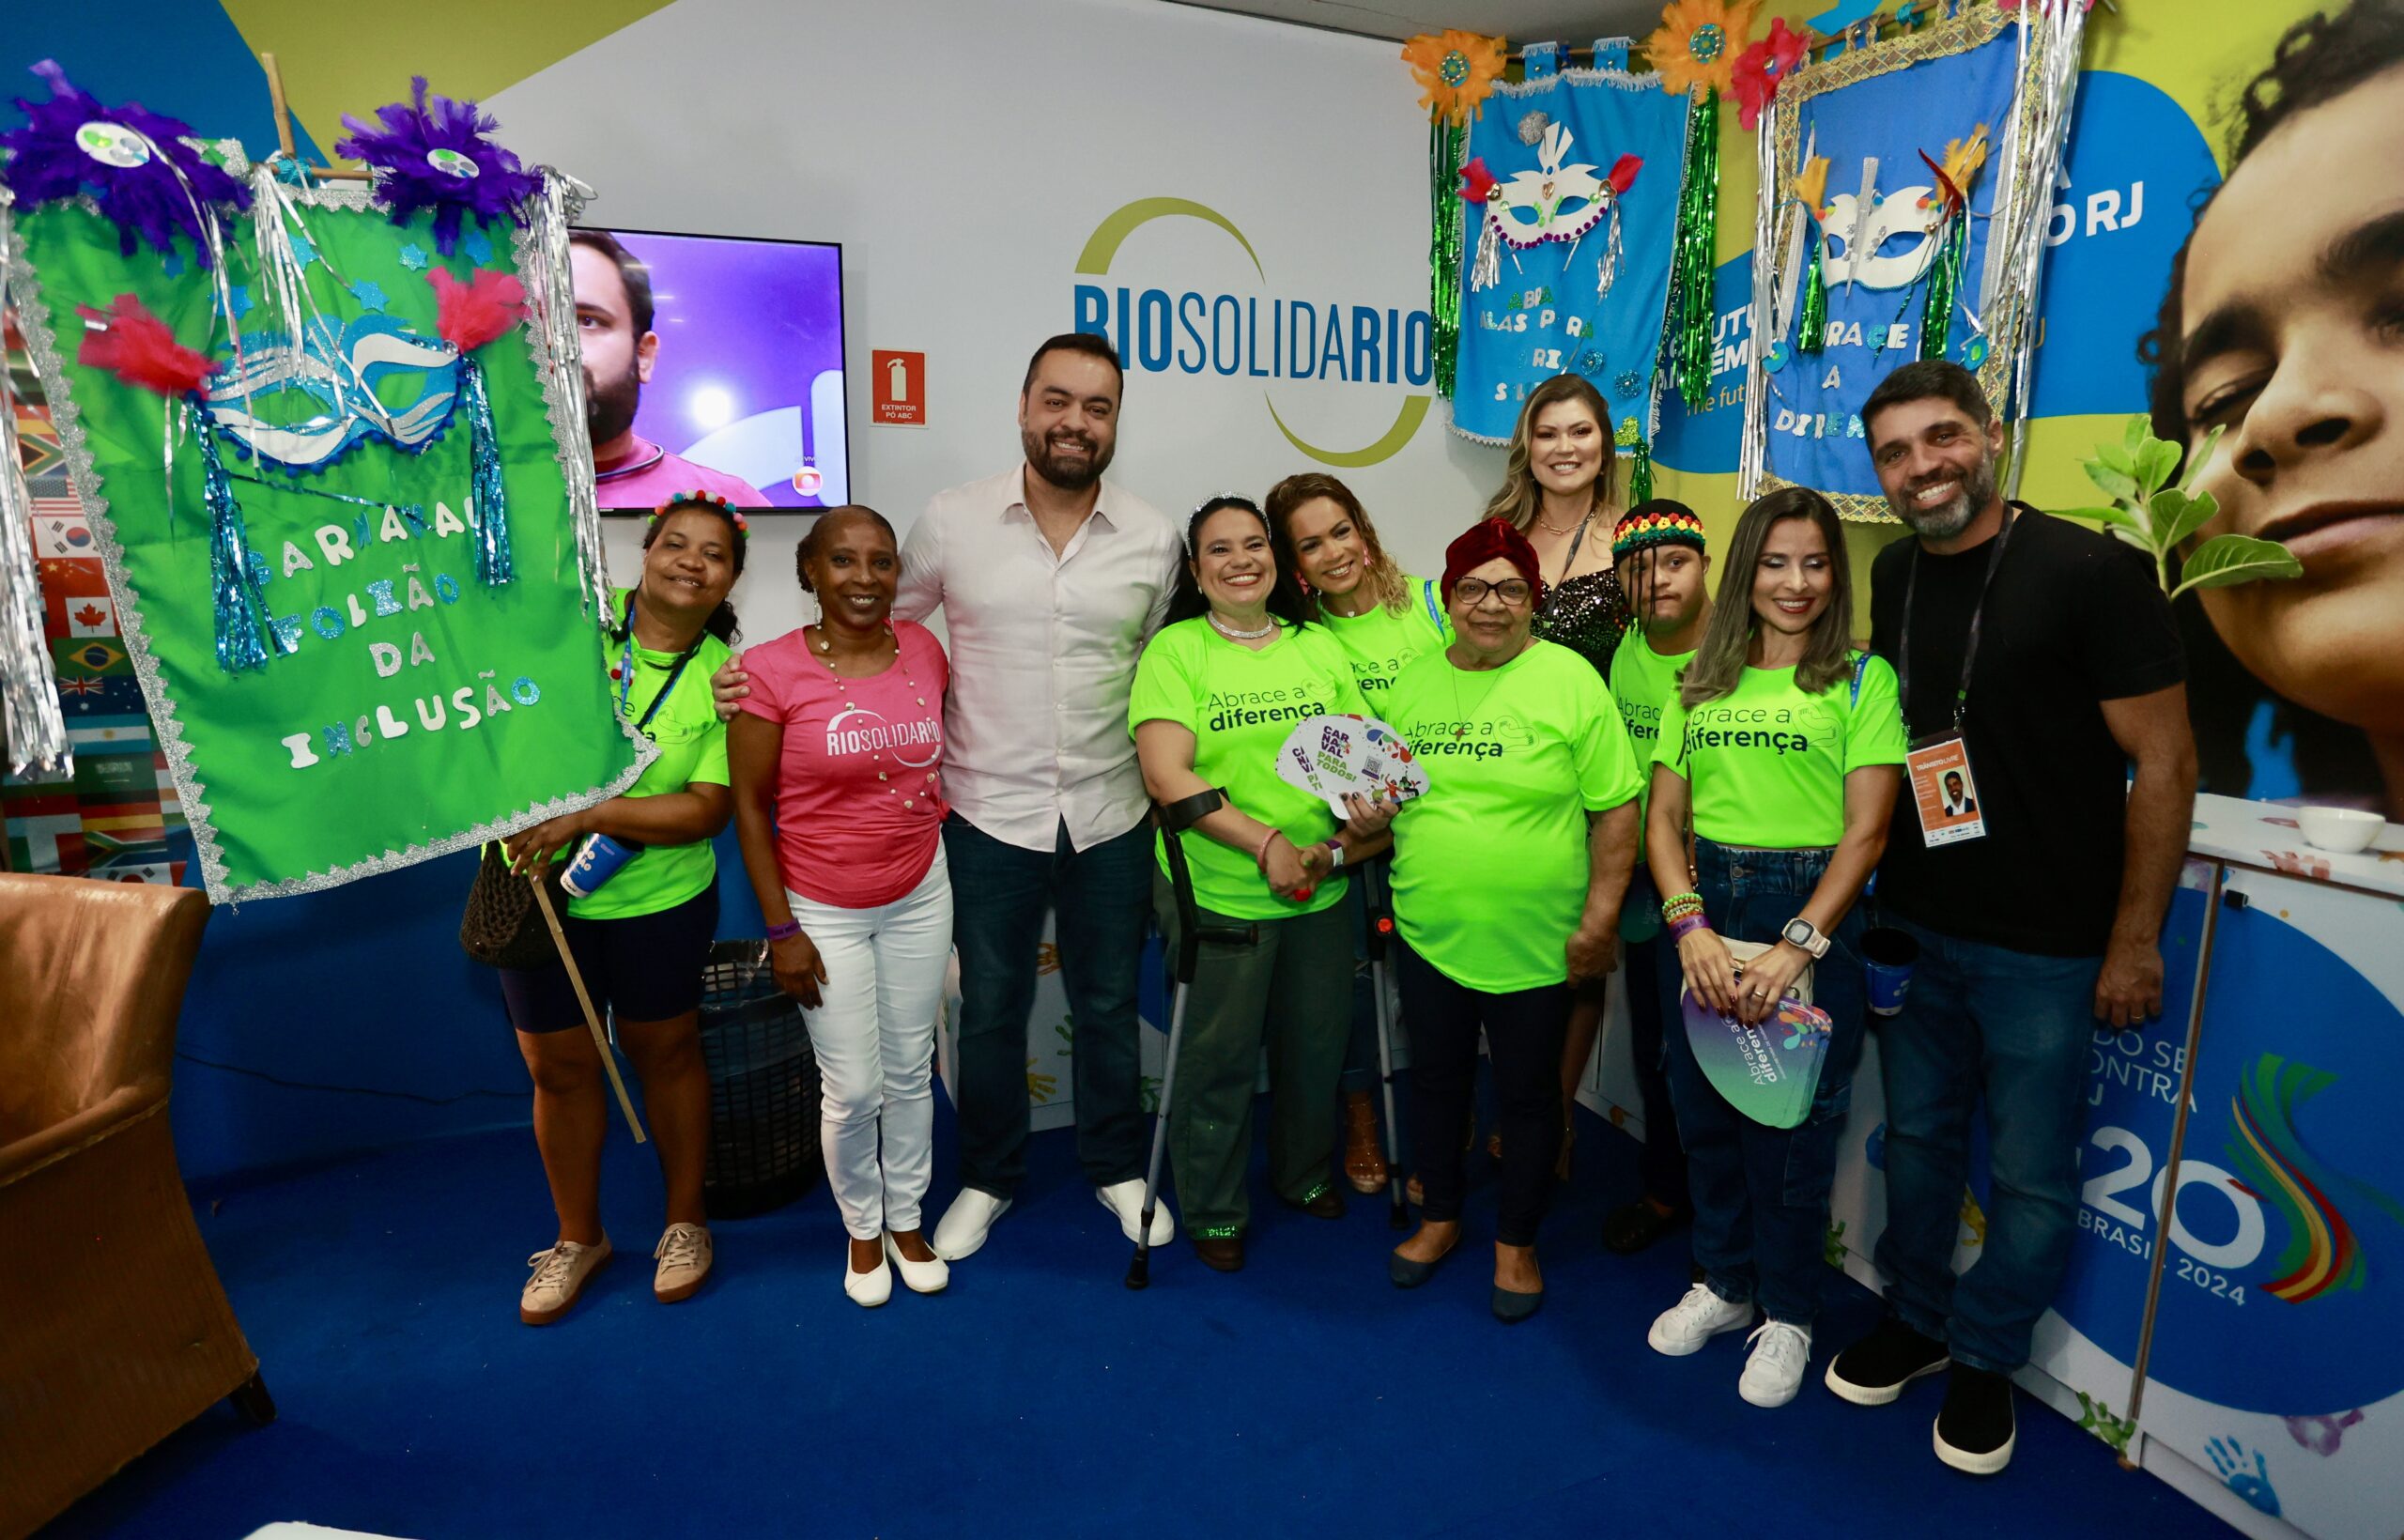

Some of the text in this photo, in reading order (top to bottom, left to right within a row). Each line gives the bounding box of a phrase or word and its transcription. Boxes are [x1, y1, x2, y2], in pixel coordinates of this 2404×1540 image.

[2086, 180, 2144, 238] RJ
[1073, 285, 1433, 386] RIOSOLIDARIO
[1821, 364, 1841, 390] A
[881, 404, 917, 412] EXTINTOR
[272, 563, 460, 655] FOLIÃO
[368, 631, 436, 678] DA
[1208, 686, 1306, 713] Abrace a
[1617, 697, 1660, 721] Abrac
[281, 669, 541, 769] INCLUSÃO
[1210, 701, 1326, 732] diferença
[1480, 721, 1493, 735] a
[1691, 708, 1791, 726] brace a
[826, 719, 941, 756] RIOSOLIDARIO
[1323, 725, 1349, 744] CAR
[1317, 750, 1347, 770] PARA
[1407, 739, 1503, 762] iferença
[1316, 759, 1358, 782] TODOS!
[1735, 1036, 1766, 1086] Abrace
[1742, 1023, 1778, 1083] diferen
[2074, 1126, 2266, 1270] 20
[2076, 1208, 2246, 1307] BRASI 2024
